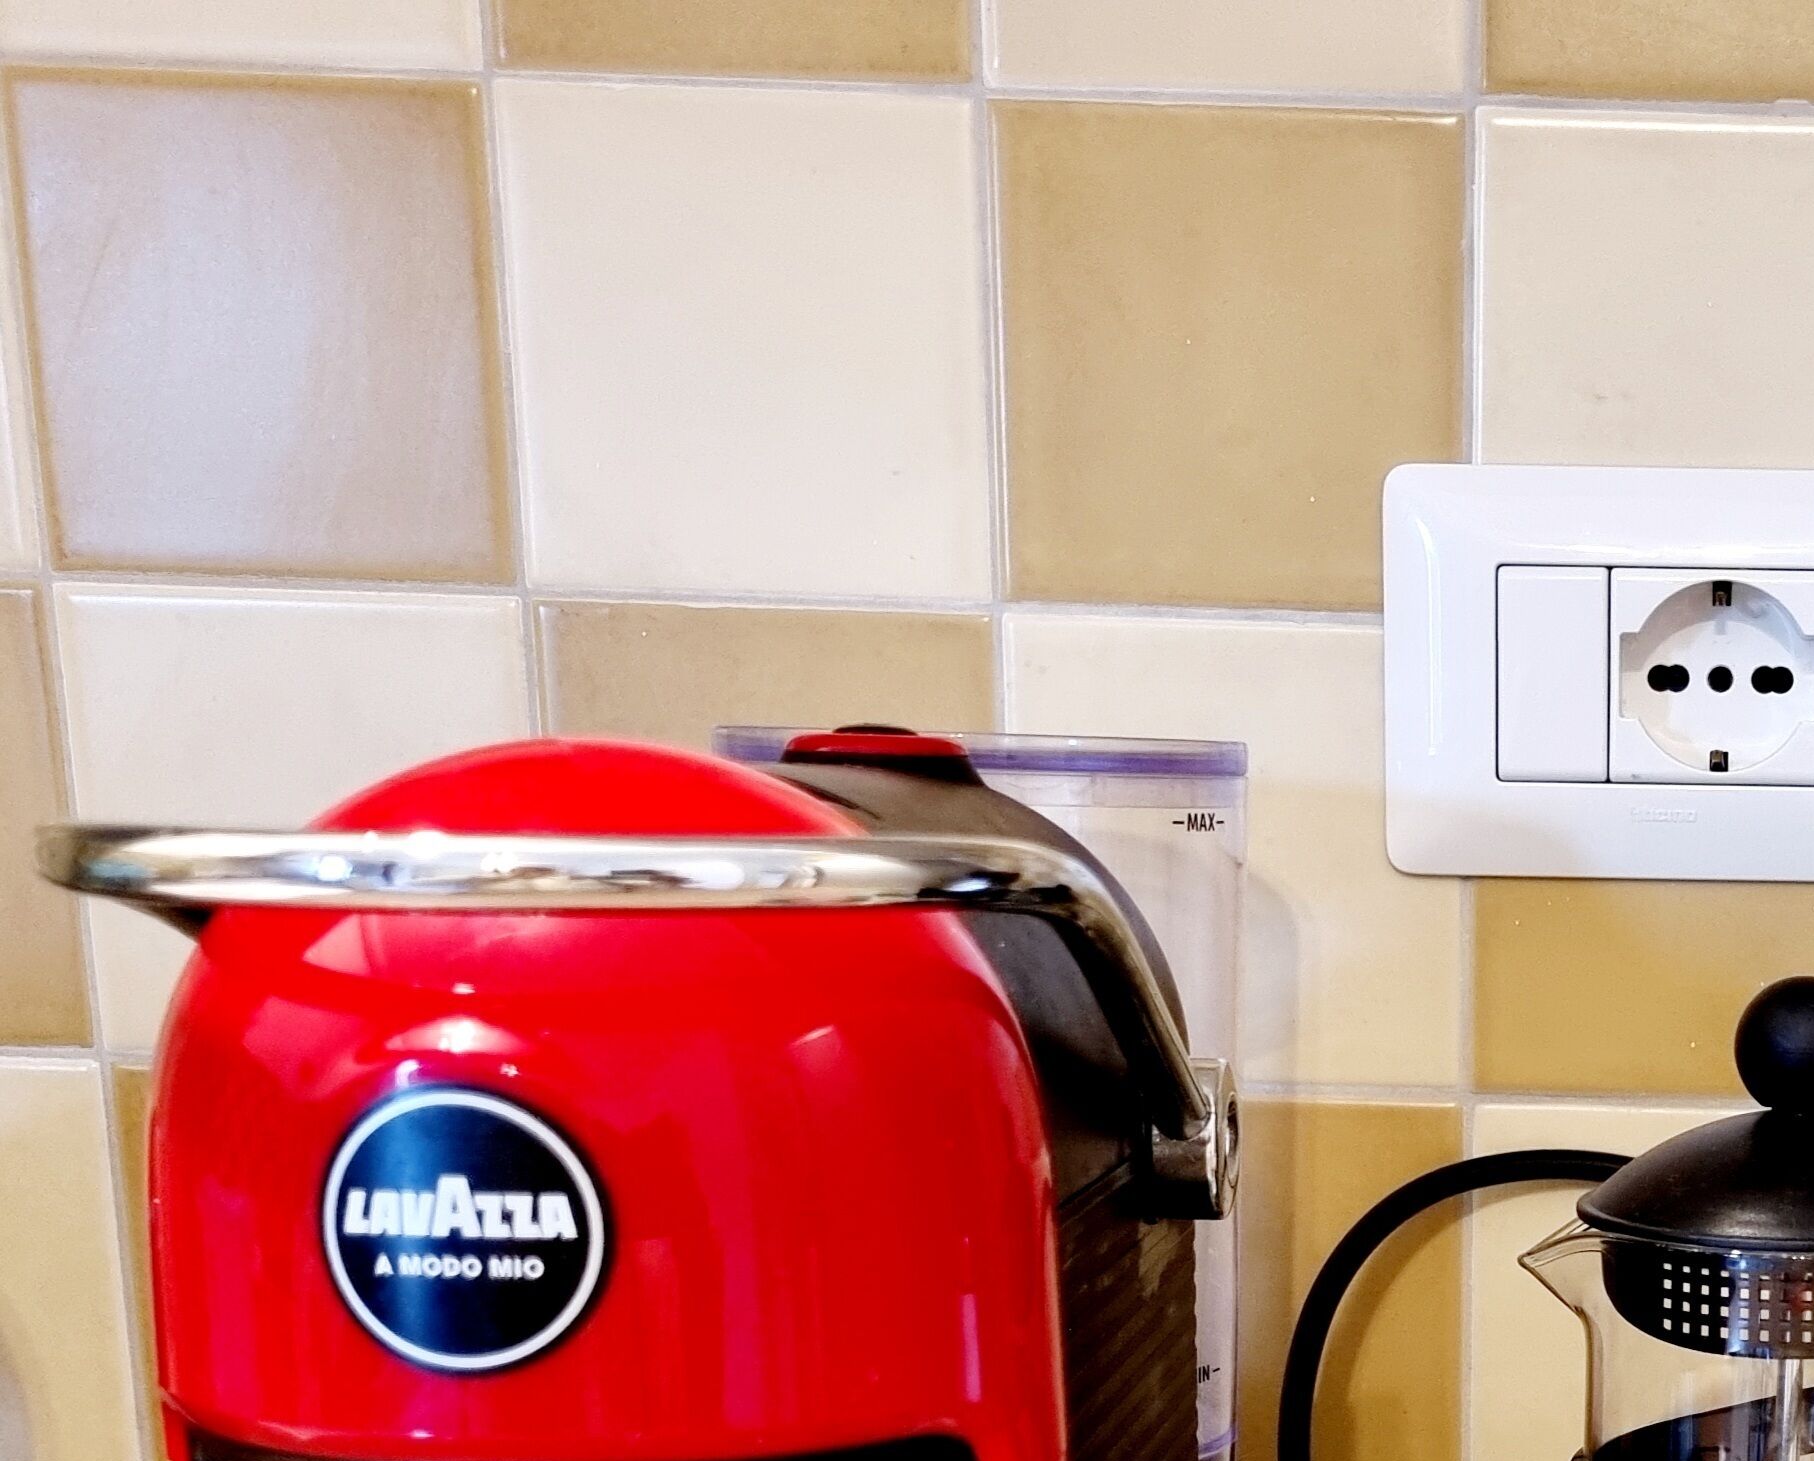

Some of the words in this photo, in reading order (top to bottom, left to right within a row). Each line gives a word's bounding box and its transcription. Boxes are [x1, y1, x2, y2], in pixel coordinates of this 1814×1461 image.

[343, 1173, 578, 1240] LAVAZZA
[374, 1253, 394, 1278] A
[400, 1254, 483, 1279] MODO
[488, 1255, 545, 1280] MIO
